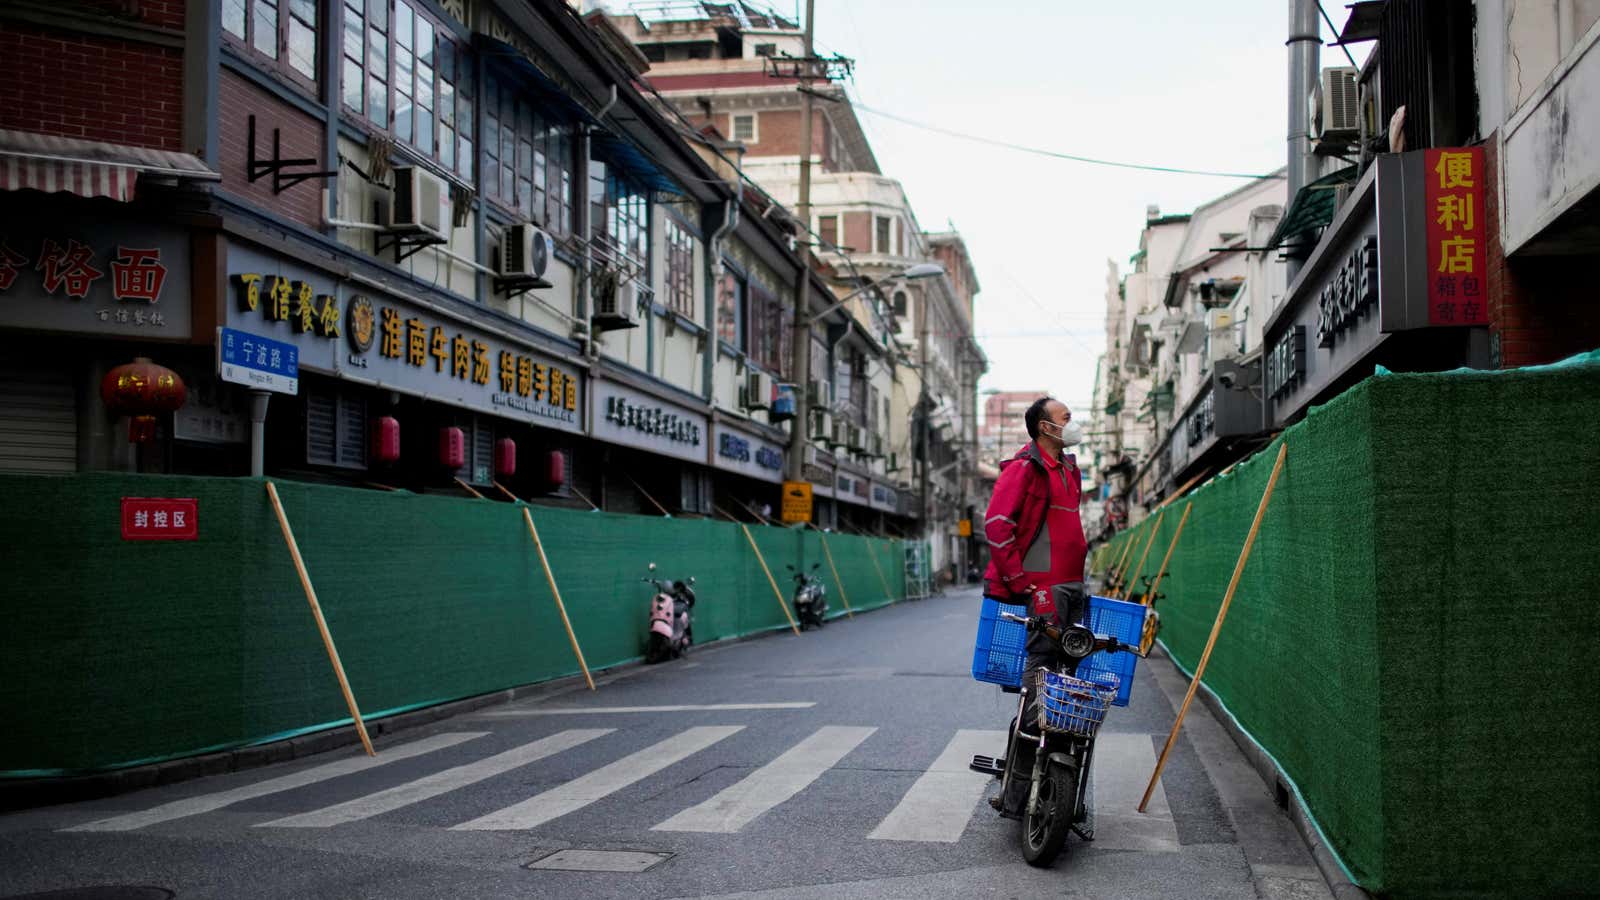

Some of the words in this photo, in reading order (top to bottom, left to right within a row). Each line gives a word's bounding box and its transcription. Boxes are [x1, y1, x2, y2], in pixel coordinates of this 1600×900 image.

[1435, 151, 1475, 274] 便利店
[1436, 275, 1480, 298] 箱包
[240, 273, 340, 337] 百信餐饮
[1437, 300, 1480, 321] 寄存
[243, 339, 281, 369] 宁波路
[382, 307, 490, 385] 淮南牛肉汤
[135, 510, 186, 528] 封控区
